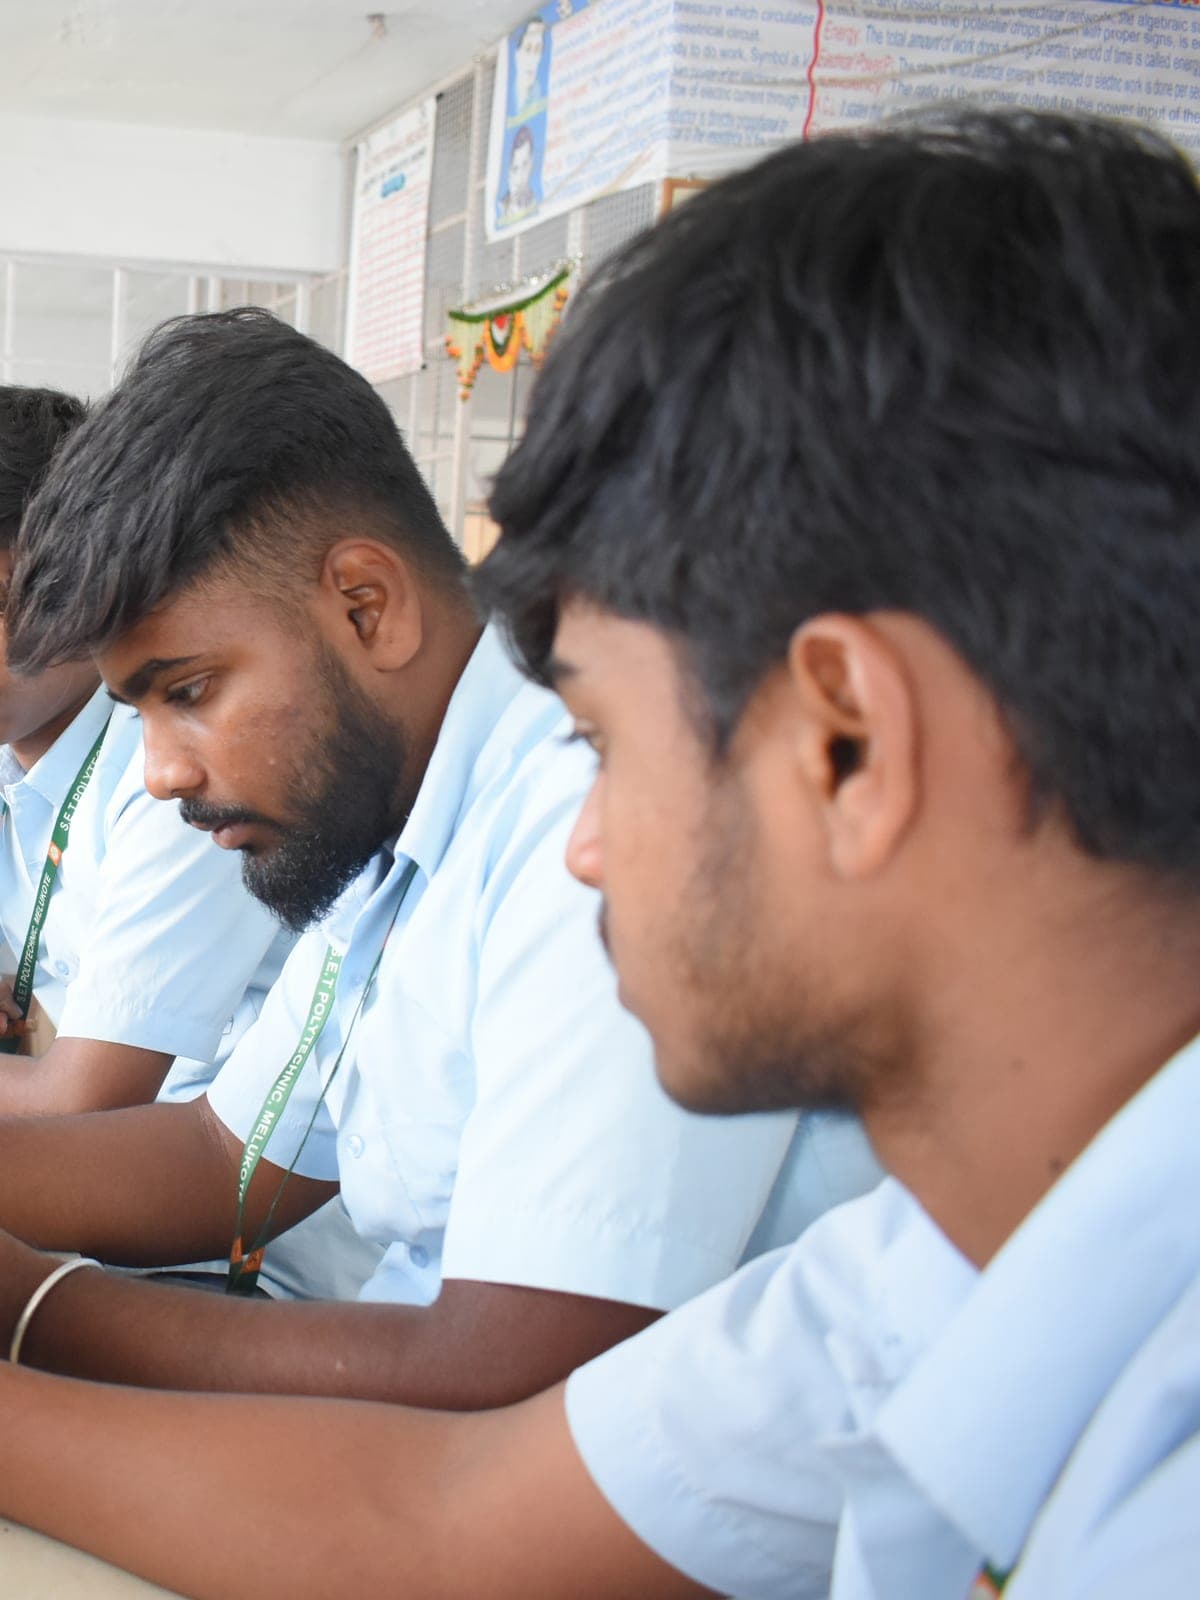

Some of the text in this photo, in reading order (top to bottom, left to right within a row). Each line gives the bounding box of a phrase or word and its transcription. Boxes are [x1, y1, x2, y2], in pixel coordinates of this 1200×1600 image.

[941, 14, 960, 27] the
[1010, 22, 1041, 39] drops
[1103, 28, 1140, 45] proper
[1137, 12, 1188, 32] algebraic
[1072, 46, 1102, 61] period
[1145, 52, 1171, 69] called
[1097, 102, 1134, 117] power
[1136, 102, 1166, 122] input
[1168, 106, 1180, 121] of
